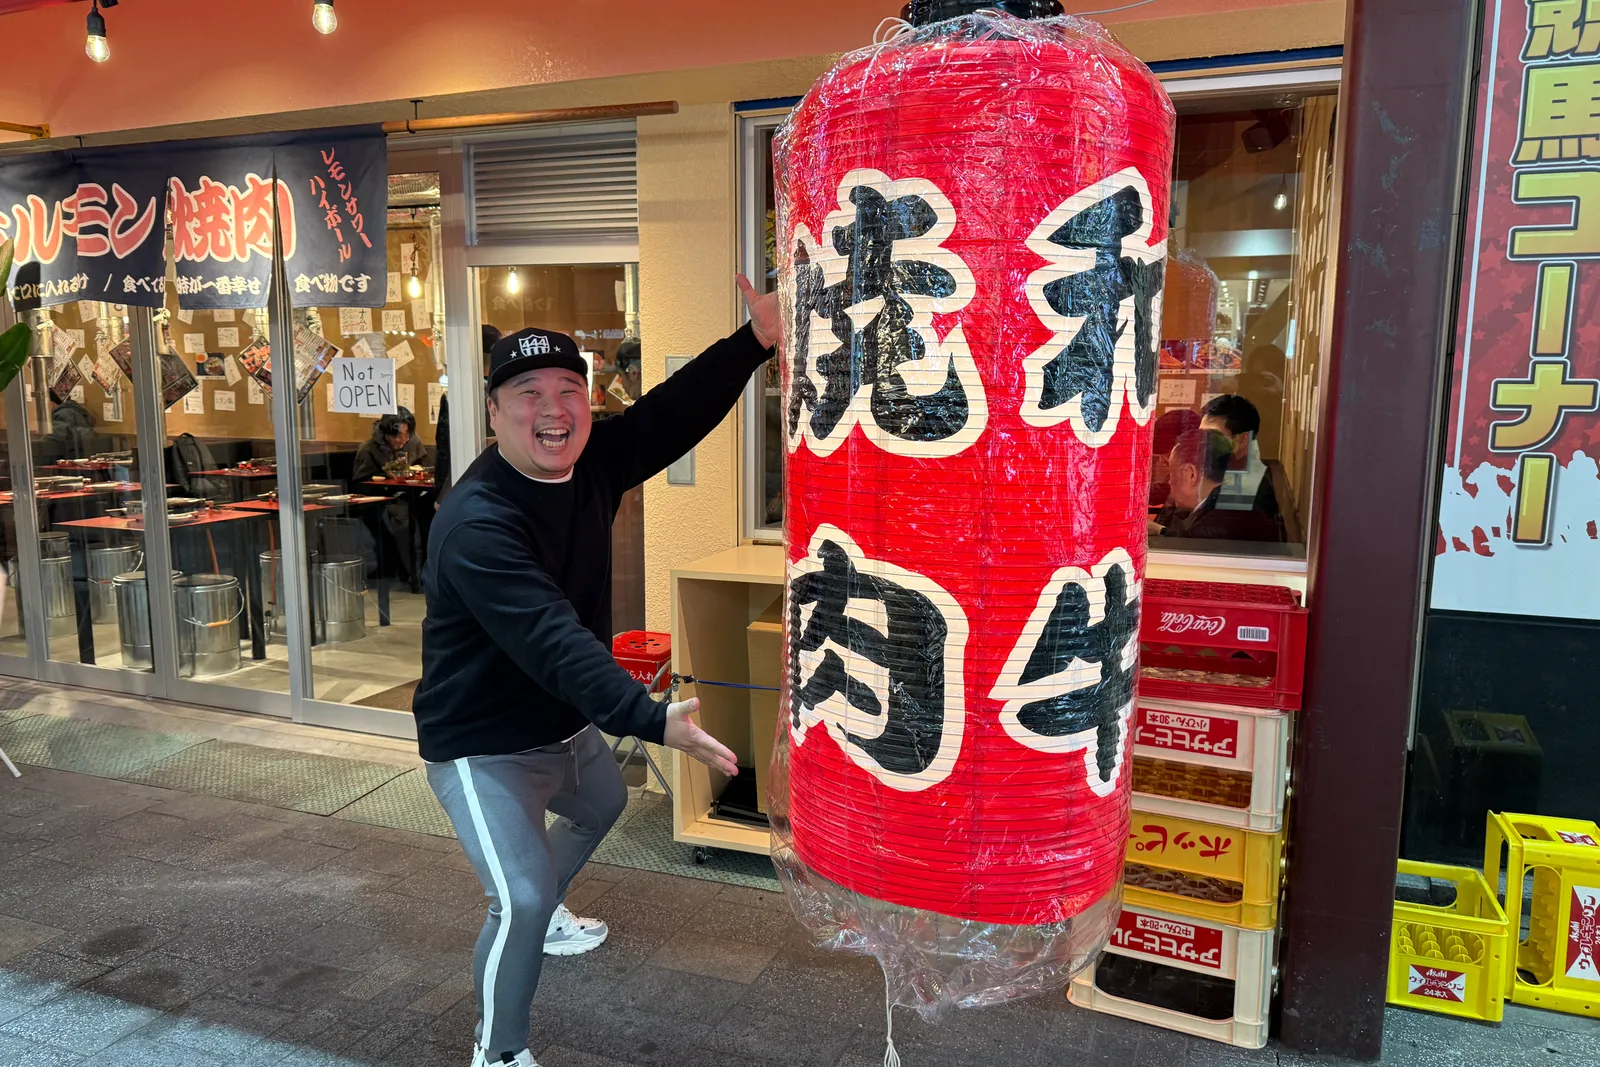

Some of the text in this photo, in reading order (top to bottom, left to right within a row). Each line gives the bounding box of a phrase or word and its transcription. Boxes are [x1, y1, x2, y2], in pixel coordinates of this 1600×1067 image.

[320, 147, 372, 248] レモンサワー
[310, 175, 351, 262] ハイボール
[294, 273, 371, 293] 食べ物です
[342, 362, 374, 381] Not
[339, 383, 391, 408] OPEN
[1569, 921, 1580, 943] Asahi
[1578, 894, 1596, 970] ウィルキンソン
[1425, 968, 1448, 979] Asahi
[1423, 988, 1449, 999] 24本入
